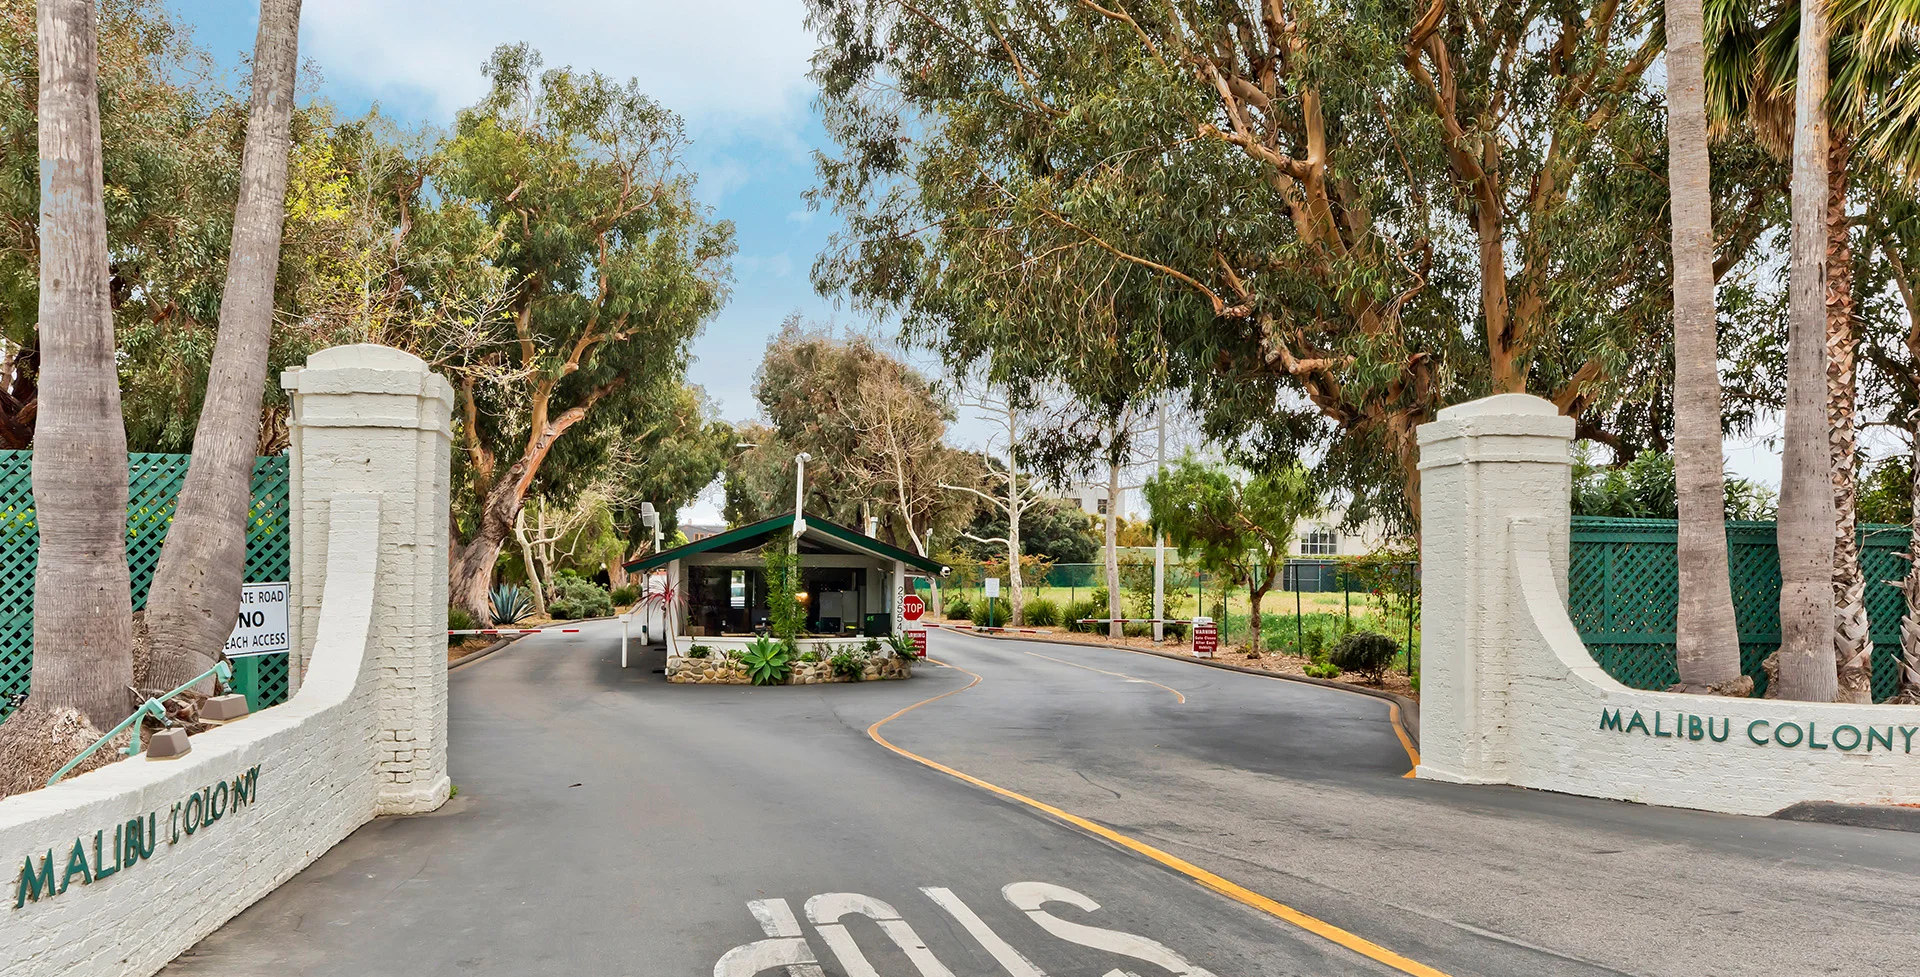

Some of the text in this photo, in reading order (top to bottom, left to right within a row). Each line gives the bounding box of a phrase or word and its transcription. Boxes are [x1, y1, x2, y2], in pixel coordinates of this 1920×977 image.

[259, 591, 284, 602] ROAD
[239, 611, 265, 628] NO
[225, 633, 285, 650] EACH ACCESS
[1600, 707, 1919, 754] MALIBU COLONY
[15, 764, 262, 909] MALIBU COLONY
